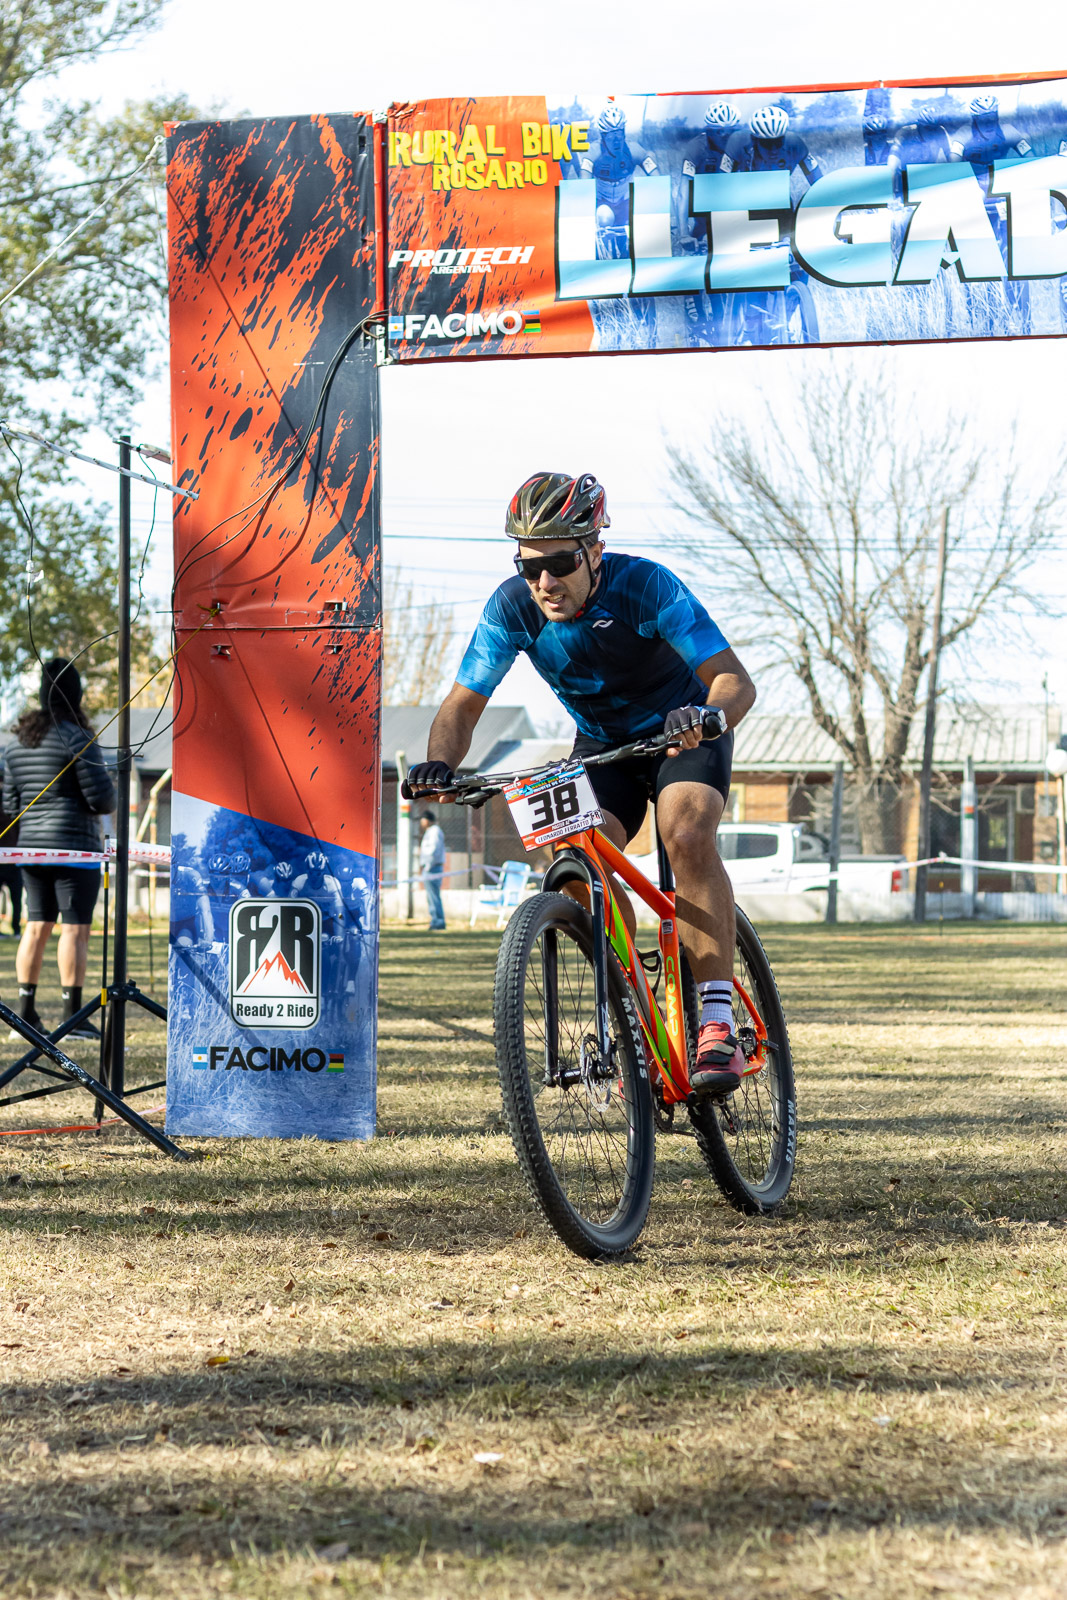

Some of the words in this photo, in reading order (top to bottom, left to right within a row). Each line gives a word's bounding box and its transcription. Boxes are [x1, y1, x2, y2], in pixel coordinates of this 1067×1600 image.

[388, 124, 506, 167] RURAL
[521, 121, 590, 161] BIKE
[432, 159, 548, 191] ROSARIO
[388, 246, 535, 268] PROTECH
[429, 264, 492, 275] ARGENTINA
[404, 310, 523, 340] FACIMO
[527, 781, 580, 831] 38
[236, 1003, 274, 1018] Ready
[276, 1004, 284, 1017] 2
[287, 1003, 314, 1018] Ride
[666, 955, 679, 1037] COMP
[621, 997, 648, 1079] MAXXIS
[209, 1046, 327, 1073] FACIMO
[785, 1098, 796, 1164] MAXXIS
